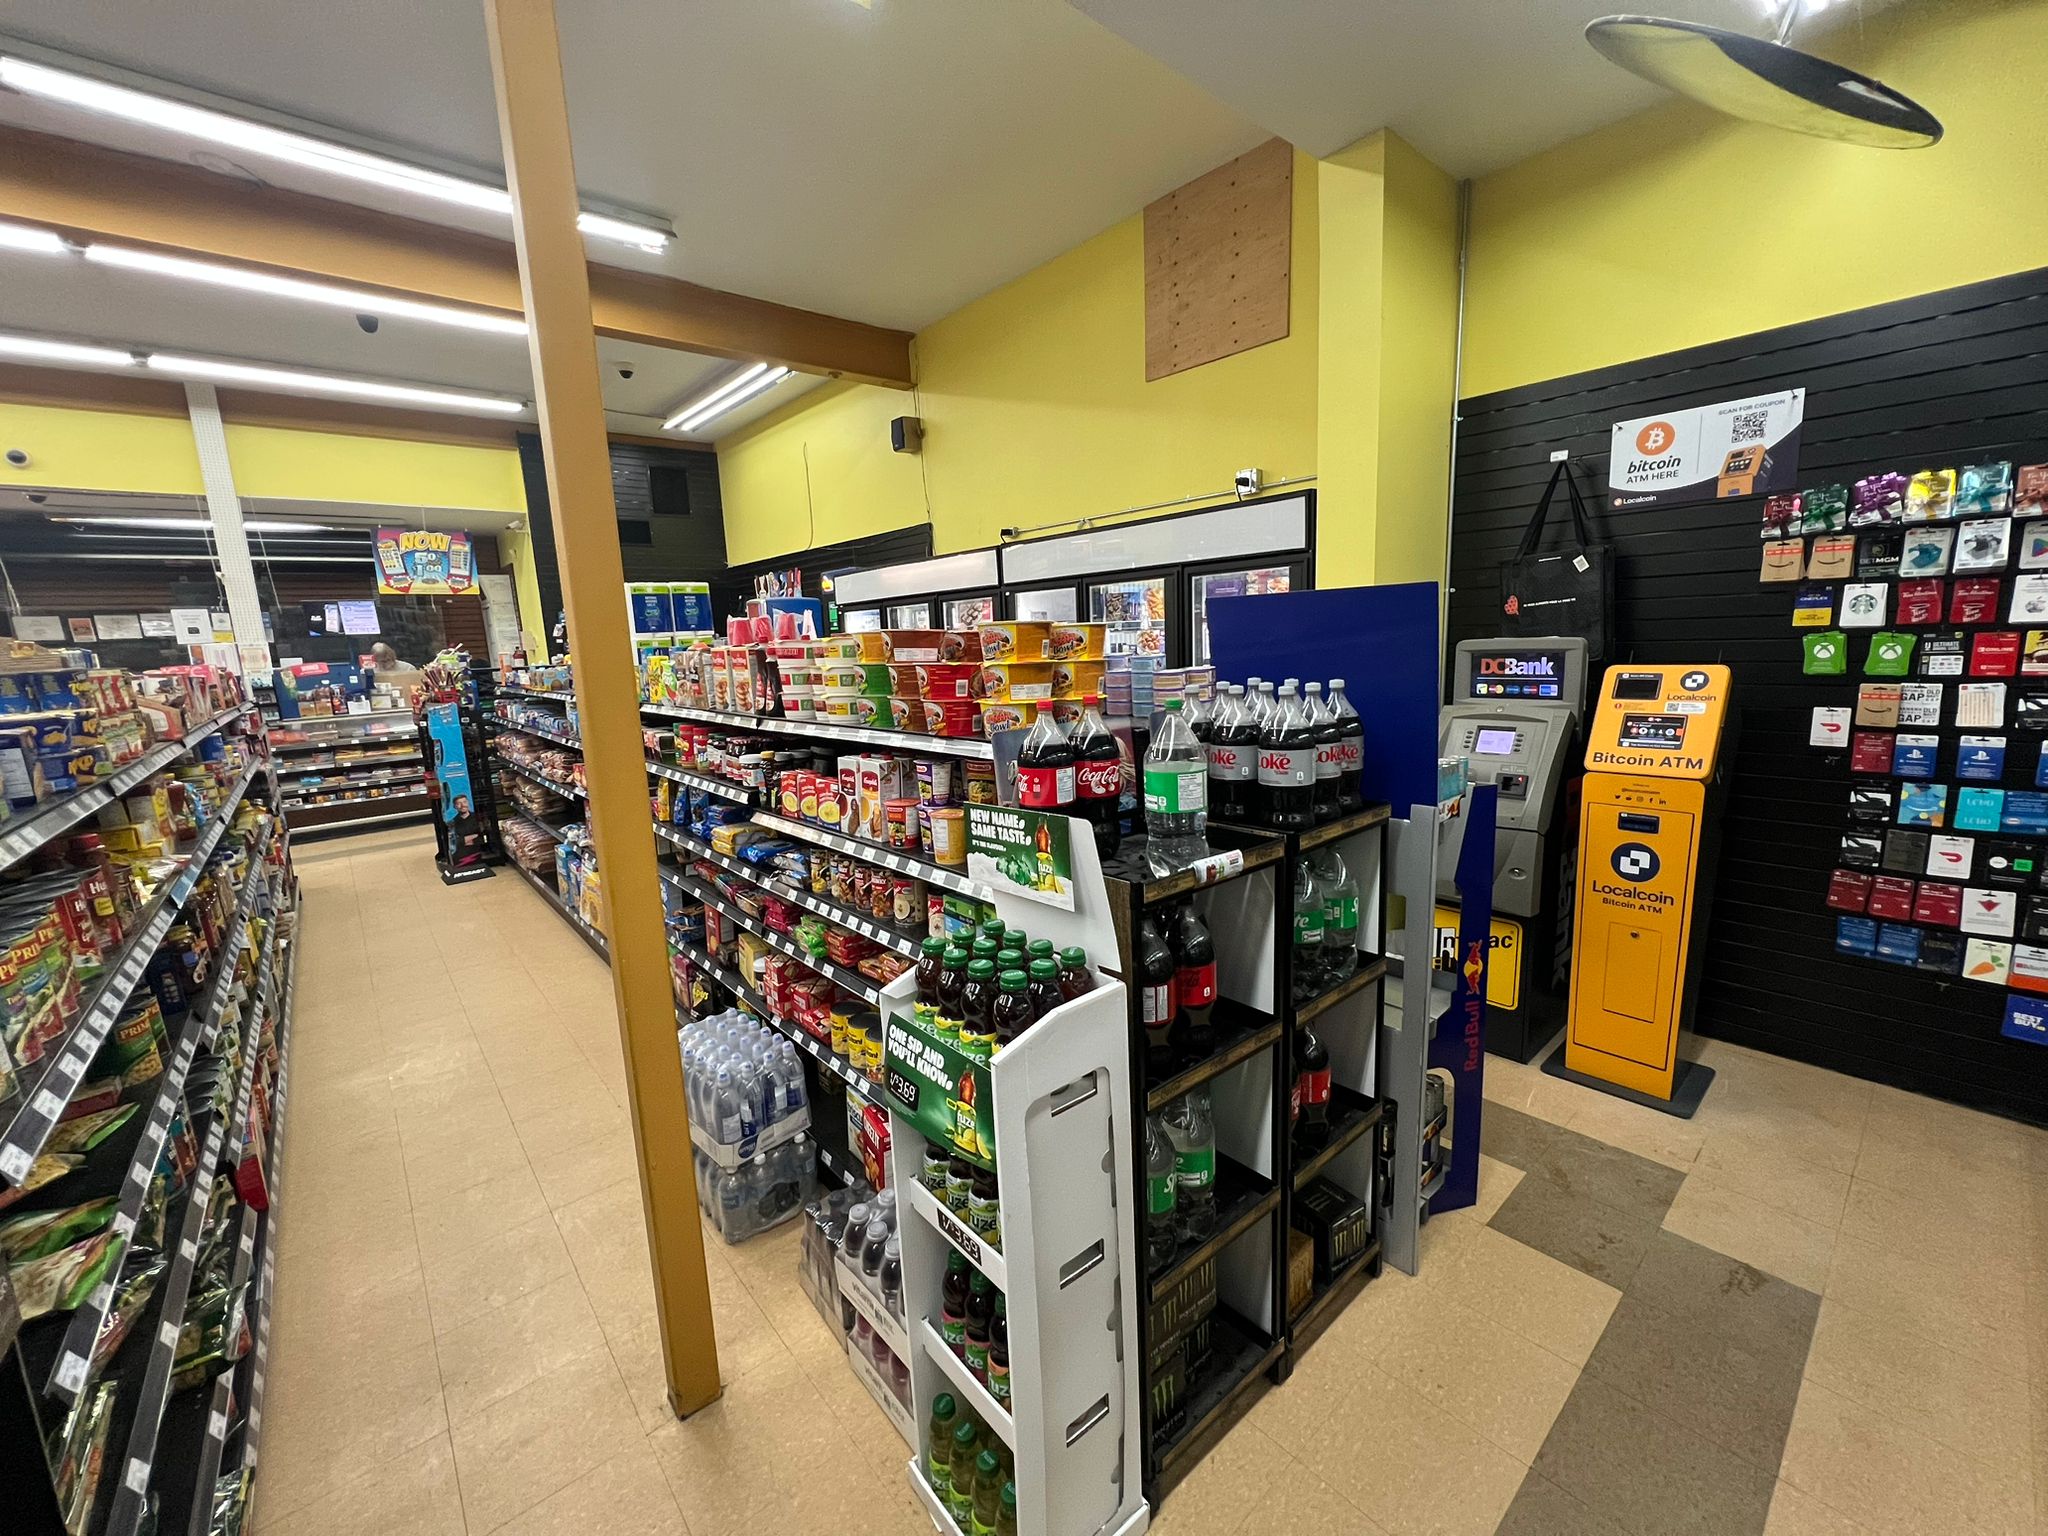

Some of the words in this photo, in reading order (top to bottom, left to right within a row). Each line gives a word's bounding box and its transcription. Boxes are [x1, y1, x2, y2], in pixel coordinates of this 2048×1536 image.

[1718, 406, 1738, 415] SCAN
[1738, 404, 1753, 412] FOR
[1754, 399, 1785, 410] COUPON
[1627, 455, 1682, 474] bitcoin
[1626, 473, 1649, 484] ATM
[1651, 469, 1680, 480] HERE
[1623, 494, 1657, 505] Localcoin
[401, 532, 450, 551] NOW
[1480, 657, 1554, 676] DCBank
[1667, 693, 1717, 702] Localcoin
[1901, 693, 1925, 701] GAP
[1898, 715, 1922, 723] GAP
[1592, 751, 1654, 767] Bitcoin
[1659, 756, 1704, 770] ATM
[970, 808, 991, 824] NEW
[970, 823, 998, 839] SAME
[1592, 880, 1675, 906] Localcoin
[1602, 897, 1636, 910] Bitcoin
[1638, 904, 1663, 914] ATM
[1464, 1000, 1480, 1037] Bull
[888, 1039, 917, 1068] YOU'LL
[889, 1024, 908, 1047] ONE
[907, 1034, 923, 1054] SIP
[923, 1043, 945, 1069] AND
[1464, 1036, 1480, 1072] Red
[925, 1175, 946, 1188] uze
[948, 1195, 969, 1209] uze
[943, 1328, 965, 1345] uze
[988, 1371, 1010, 1397] fuz
